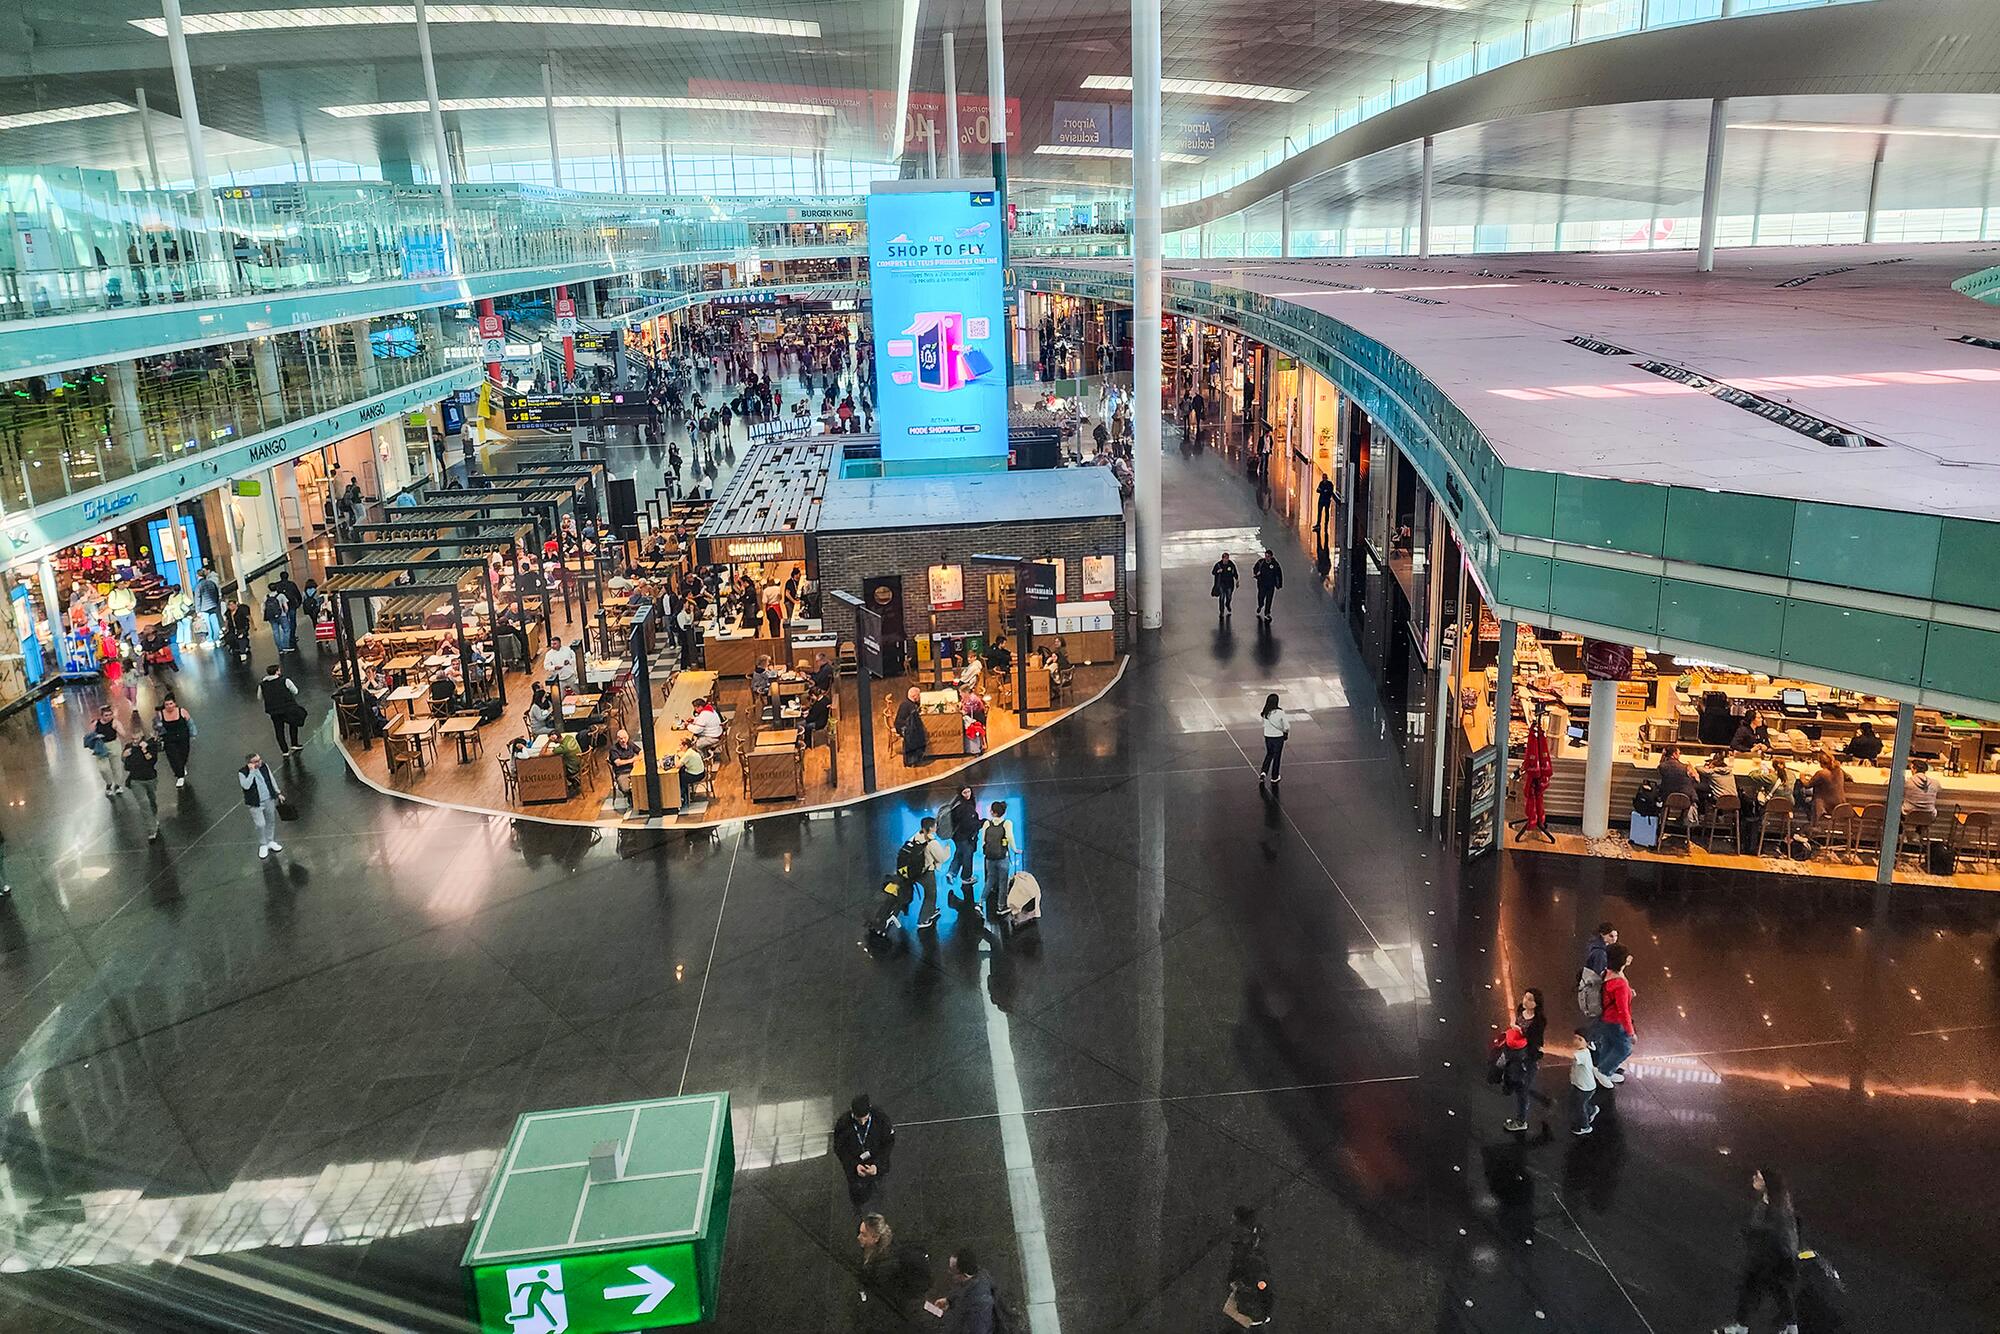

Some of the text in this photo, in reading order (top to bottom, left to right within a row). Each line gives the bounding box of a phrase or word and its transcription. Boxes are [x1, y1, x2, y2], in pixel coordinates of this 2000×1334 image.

[833, 209, 854, 217] KING
[888, 243, 985, 257] SHOP TO FLY
[973, 257, 998, 265] ONLINE
[359, 402, 386, 423] MANGO
[249, 437, 287, 463] MANGO
[97, 492, 139, 517] Hudson
[728, 539, 784, 557] SANTAMARÍA
[1025, 586, 1054, 597] SANTAMARÍA
